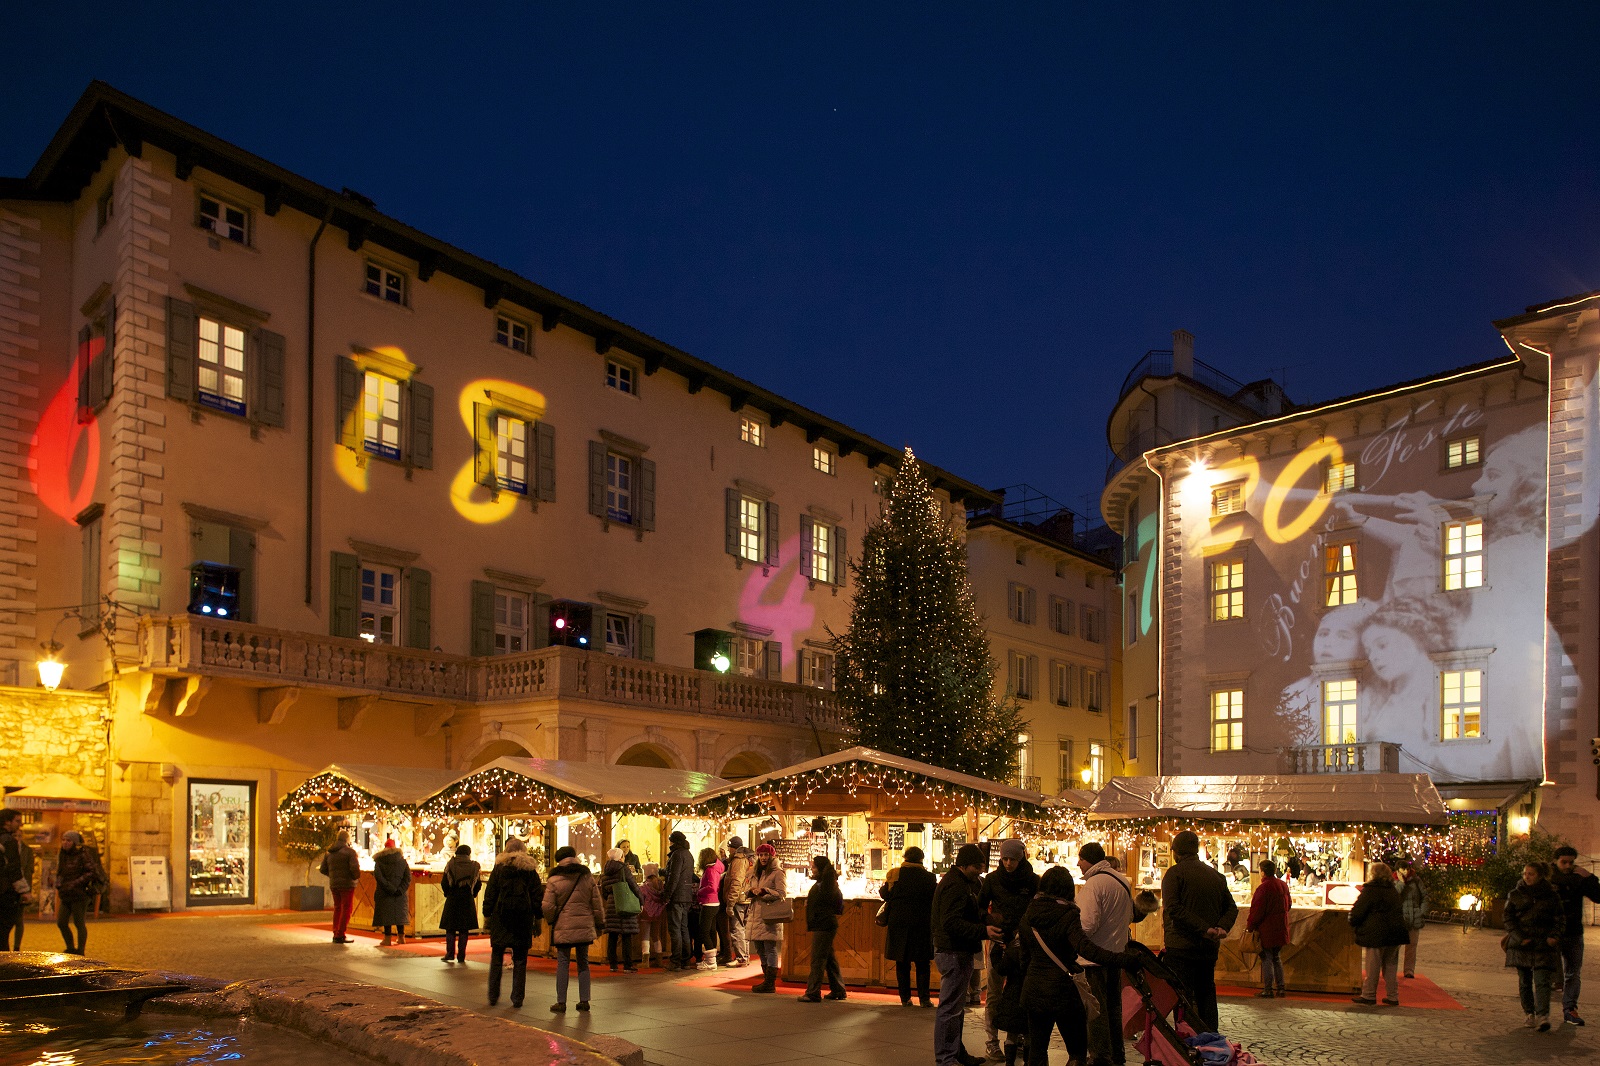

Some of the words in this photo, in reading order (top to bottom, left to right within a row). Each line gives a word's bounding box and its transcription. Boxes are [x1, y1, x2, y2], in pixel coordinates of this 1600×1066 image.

[738, 526, 816, 670] 4
[1261, 514, 1339, 663] Buone
[1359, 399, 1484, 492] Feste
